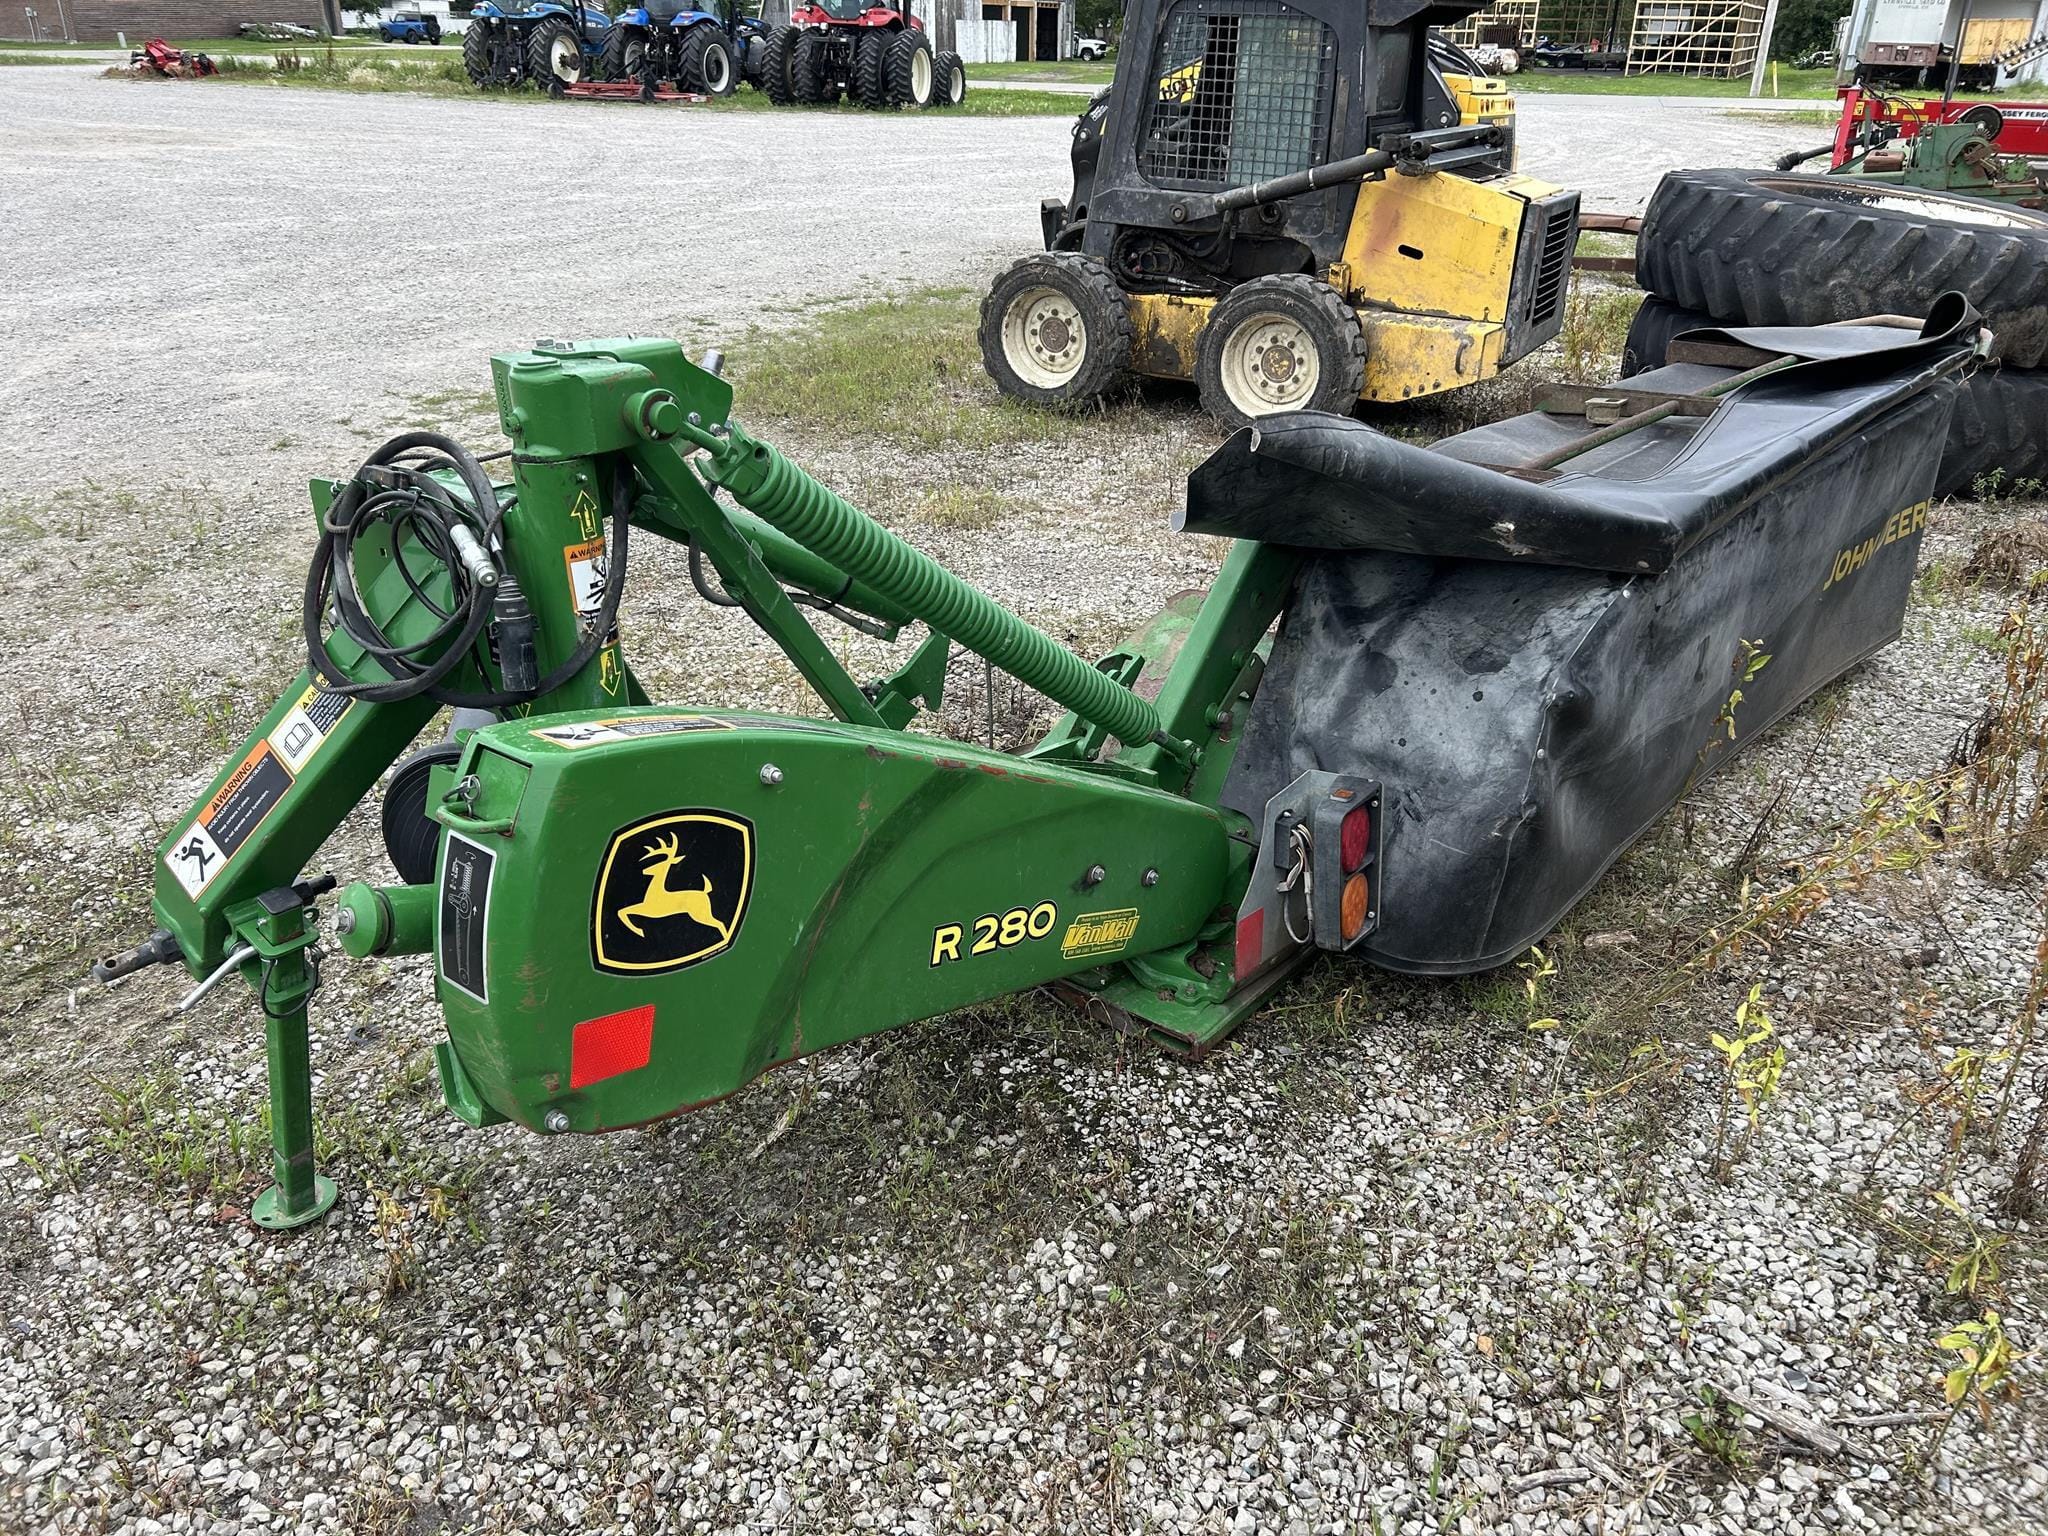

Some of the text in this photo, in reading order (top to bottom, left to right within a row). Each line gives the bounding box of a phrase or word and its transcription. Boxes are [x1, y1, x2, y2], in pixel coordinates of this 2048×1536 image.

[2025, 110, 2048, 118] FERG
[1878, 497, 1931, 546] EER
[216, 760, 253, 805] WARNING
[929, 899, 1058, 969] R 280
